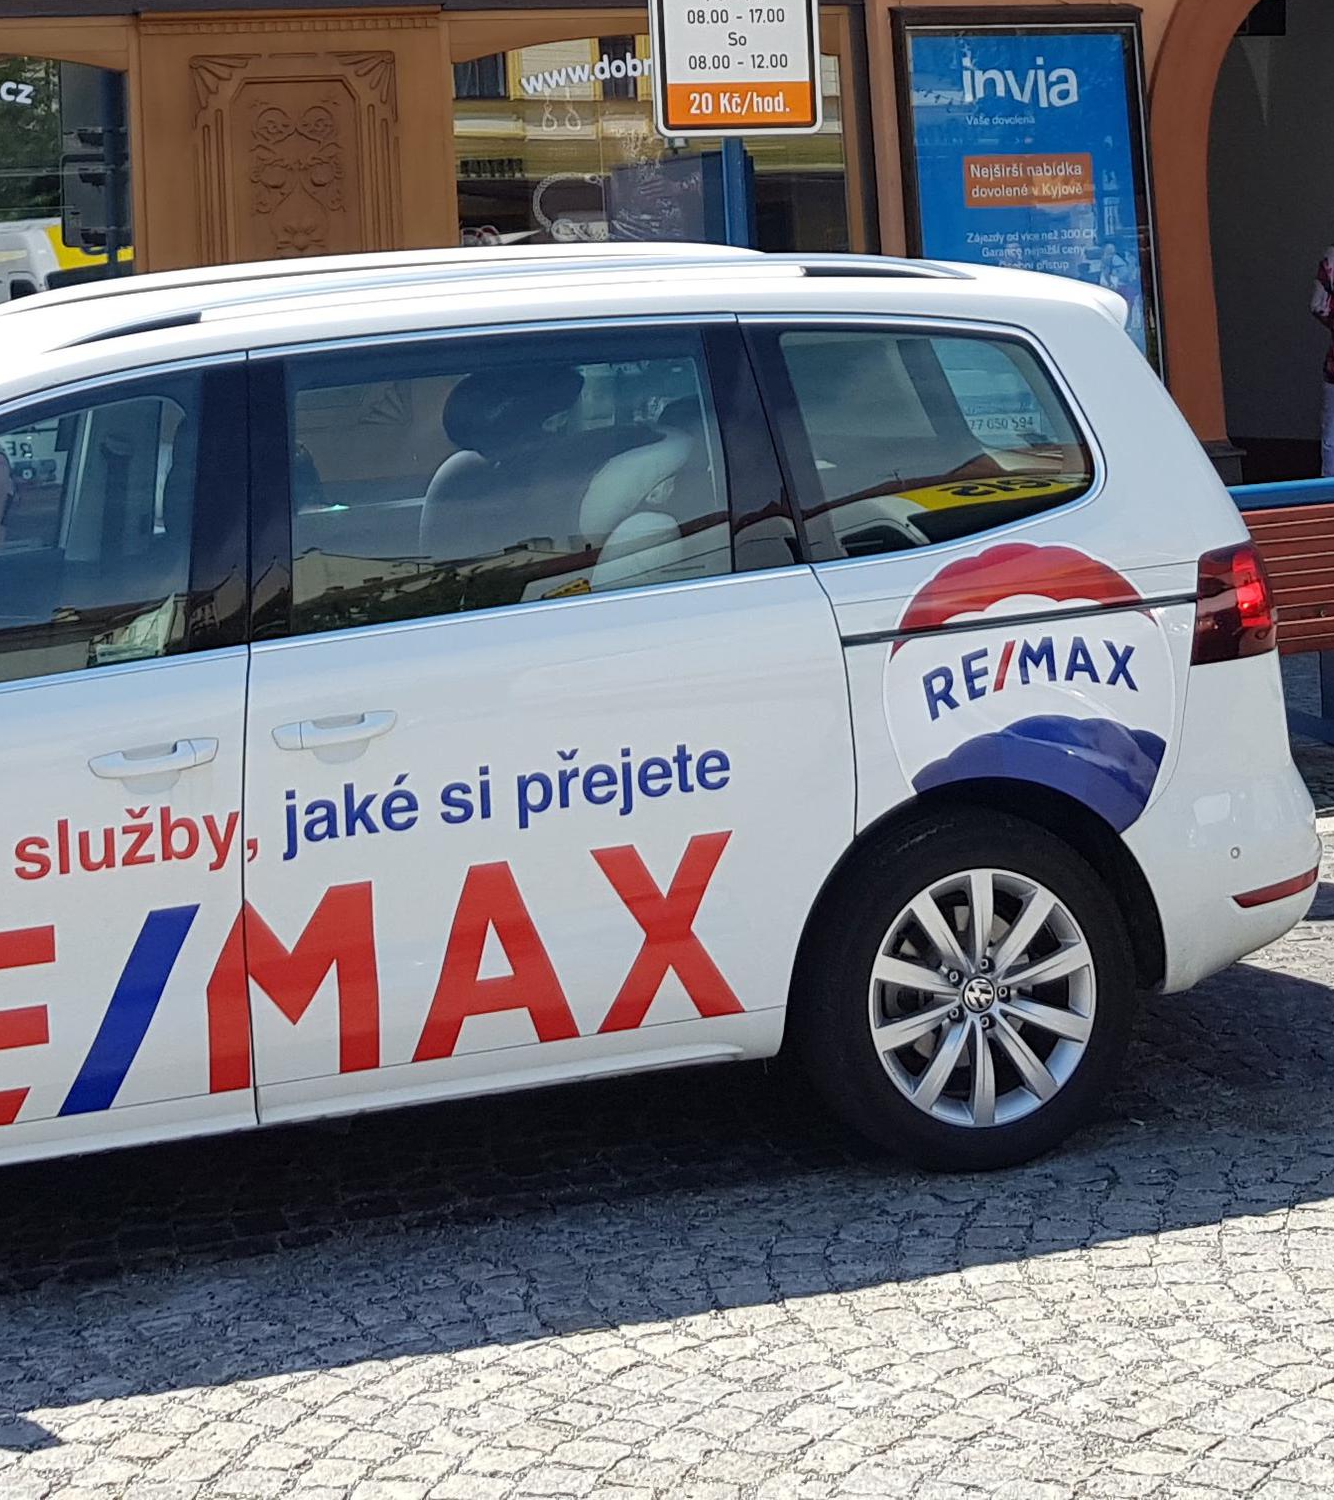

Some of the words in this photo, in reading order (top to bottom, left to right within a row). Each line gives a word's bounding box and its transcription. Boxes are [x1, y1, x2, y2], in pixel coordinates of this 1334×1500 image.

[687, 9, 730, 25] 08.00
[748, 8, 785, 24] 17.00
[727, 32, 748, 48] So
[520, 52, 652, 95] www.dobr
[688, 55, 731, 71] 08.00
[750, 54, 789, 70] 12.00
[962, 56, 1079, 108] invia
[689, 92, 713, 115] 20
[719, 90, 791, 115] Kč/hod.
[970, 163, 1023, 181] Nejširší
[1026, 161, 1083, 177] nabídka
[922, 634, 1139, 723] RE/MAX
[13, 802, 261, 880] služby,
[281, 773, 421, 858] jaké
[438, 764, 492, 824] si
[515, 740, 733, 829] přejete
